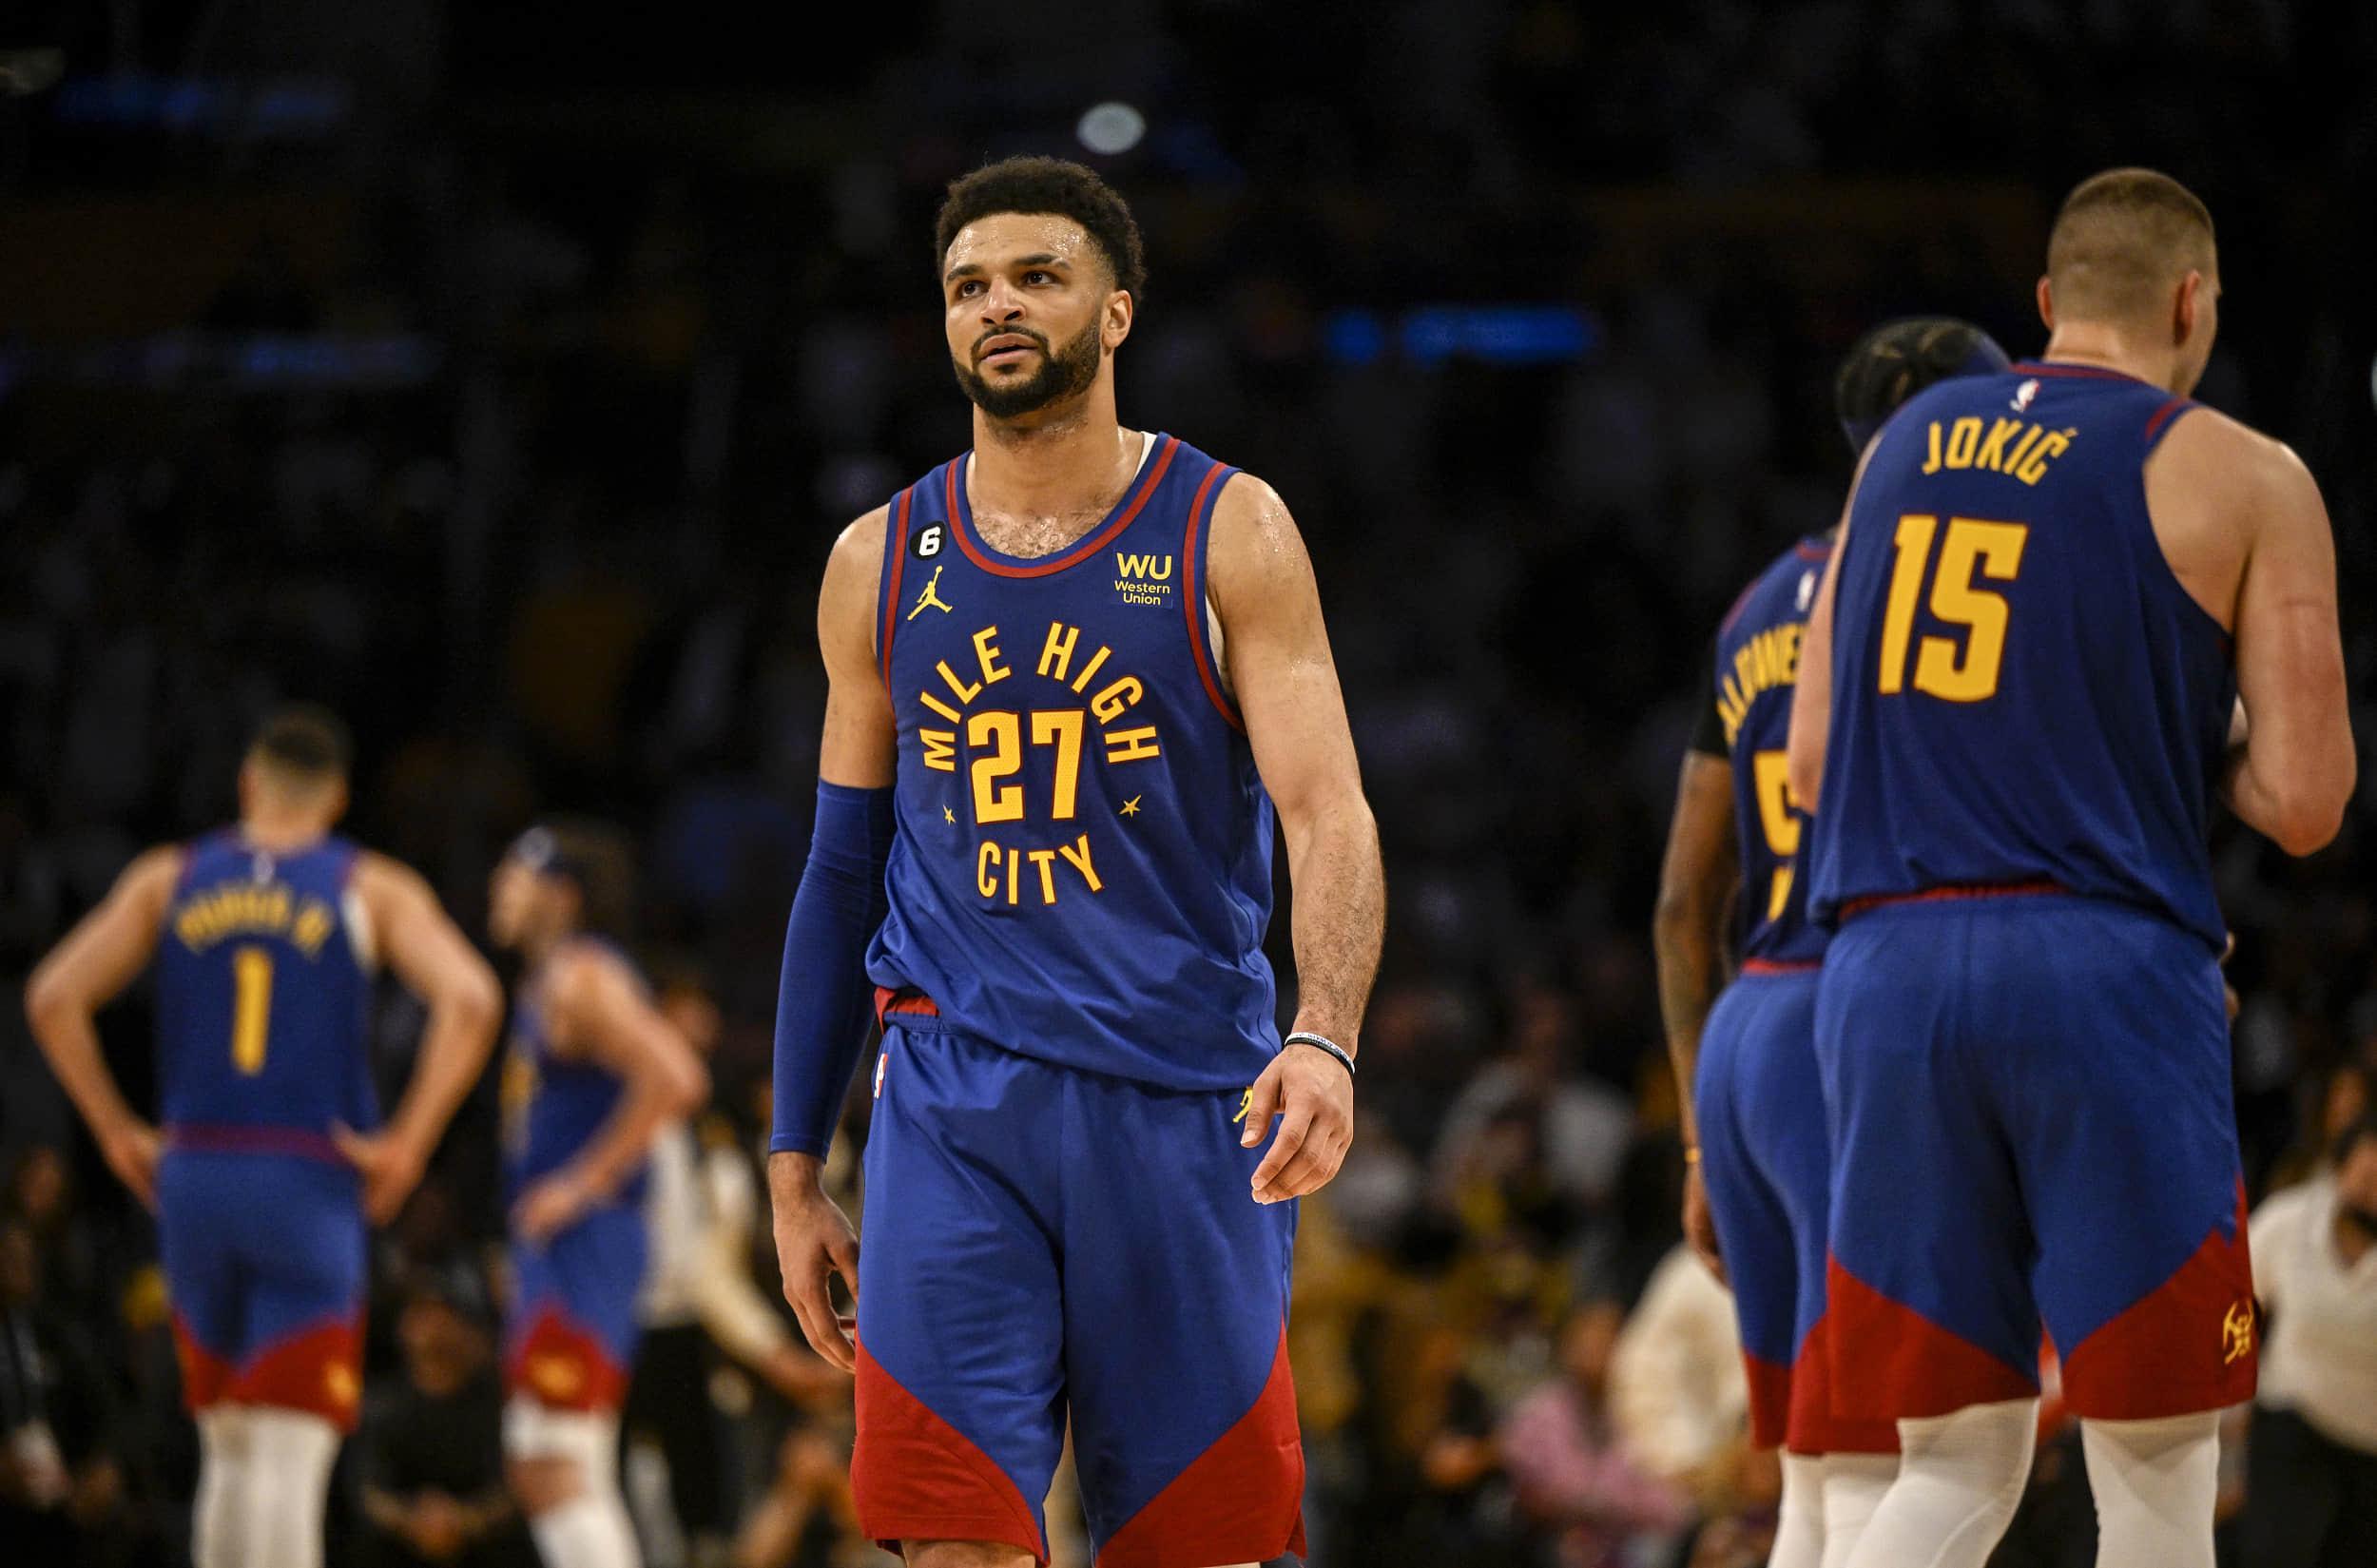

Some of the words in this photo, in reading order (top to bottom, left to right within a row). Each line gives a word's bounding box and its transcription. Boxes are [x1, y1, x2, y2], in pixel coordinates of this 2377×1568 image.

[1922, 416, 2078, 486] JOKIĆ
[918, 526, 941, 556] 6
[1115, 552, 1172, 580] WU
[1113, 579, 1170, 594] Western
[1123, 592, 1161, 606] Union
[1877, 512, 2030, 704] 15
[918, 625, 1013, 773] MILE
[1035, 620, 1161, 765] HIGH
[966, 707, 1086, 825] 27
[976, 831, 1105, 906] CITY
[232, 947, 273, 1075] 1
